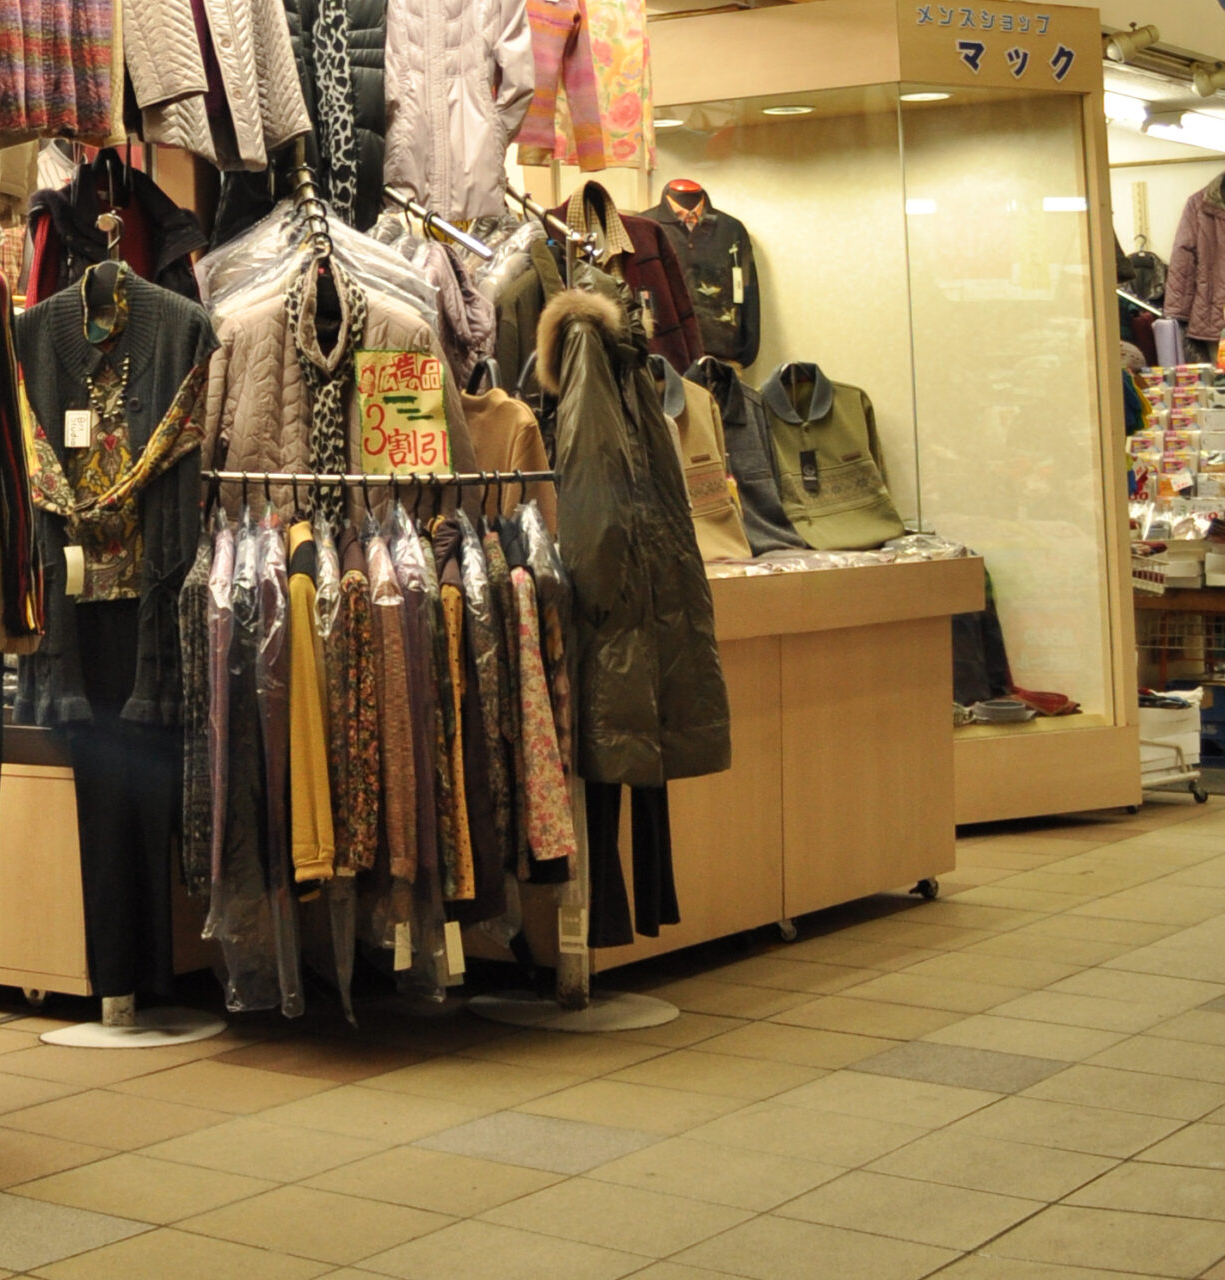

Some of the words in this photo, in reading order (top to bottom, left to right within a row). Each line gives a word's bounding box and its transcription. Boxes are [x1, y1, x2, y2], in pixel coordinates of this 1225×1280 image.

[956, 40, 1075, 83] マック
[363, 403, 449, 469] 3割引
